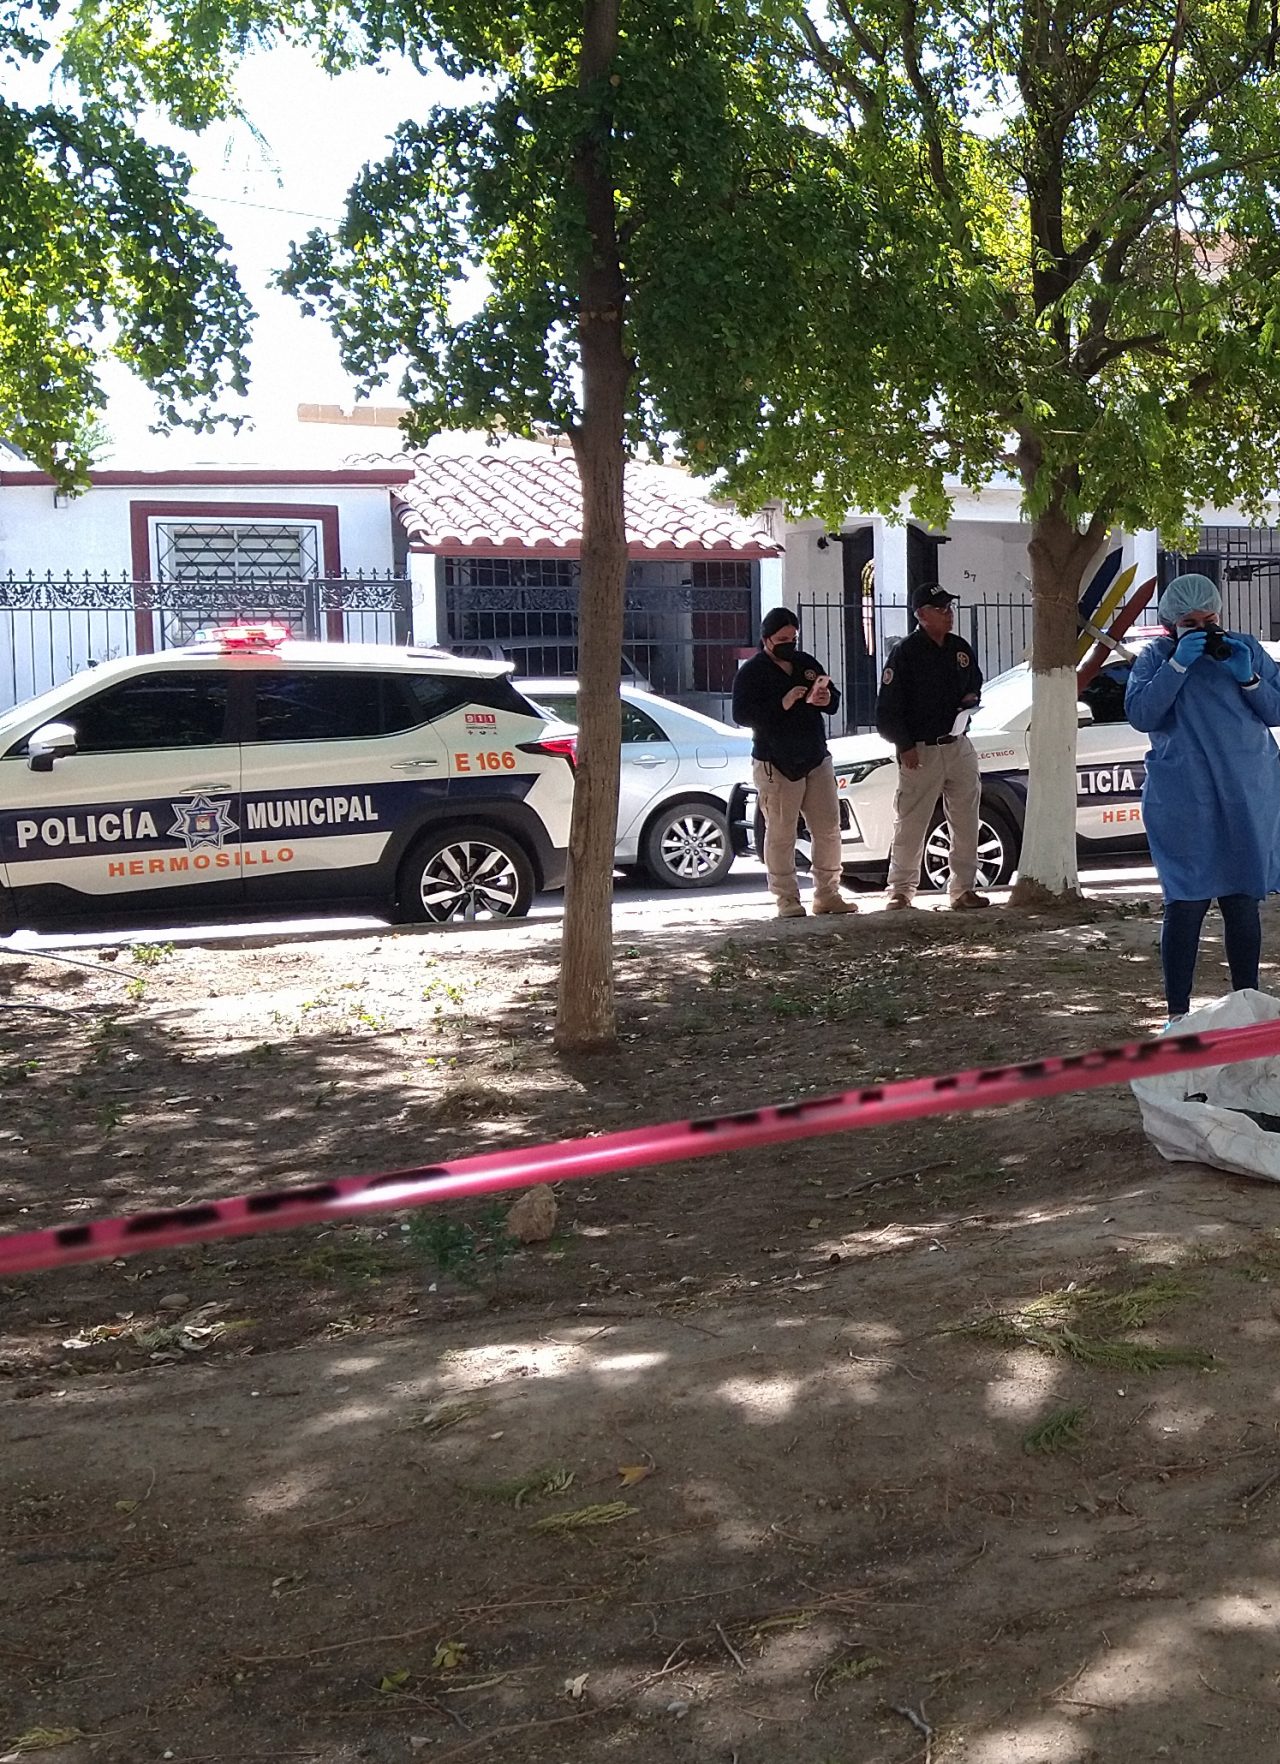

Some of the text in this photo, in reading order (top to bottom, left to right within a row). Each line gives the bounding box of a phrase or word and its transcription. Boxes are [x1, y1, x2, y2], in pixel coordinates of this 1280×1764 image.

[963, 570, 977, 582] 57
[465, 713, 496, 723] 911
[455, 751, 516, 771] E 166
[1076, 765, 1136, 795] LICÍA
[16, 795, 379, 849] POLICÍA MUNICIPAL
[107, 847, 295, 878] HERMOSILLO
